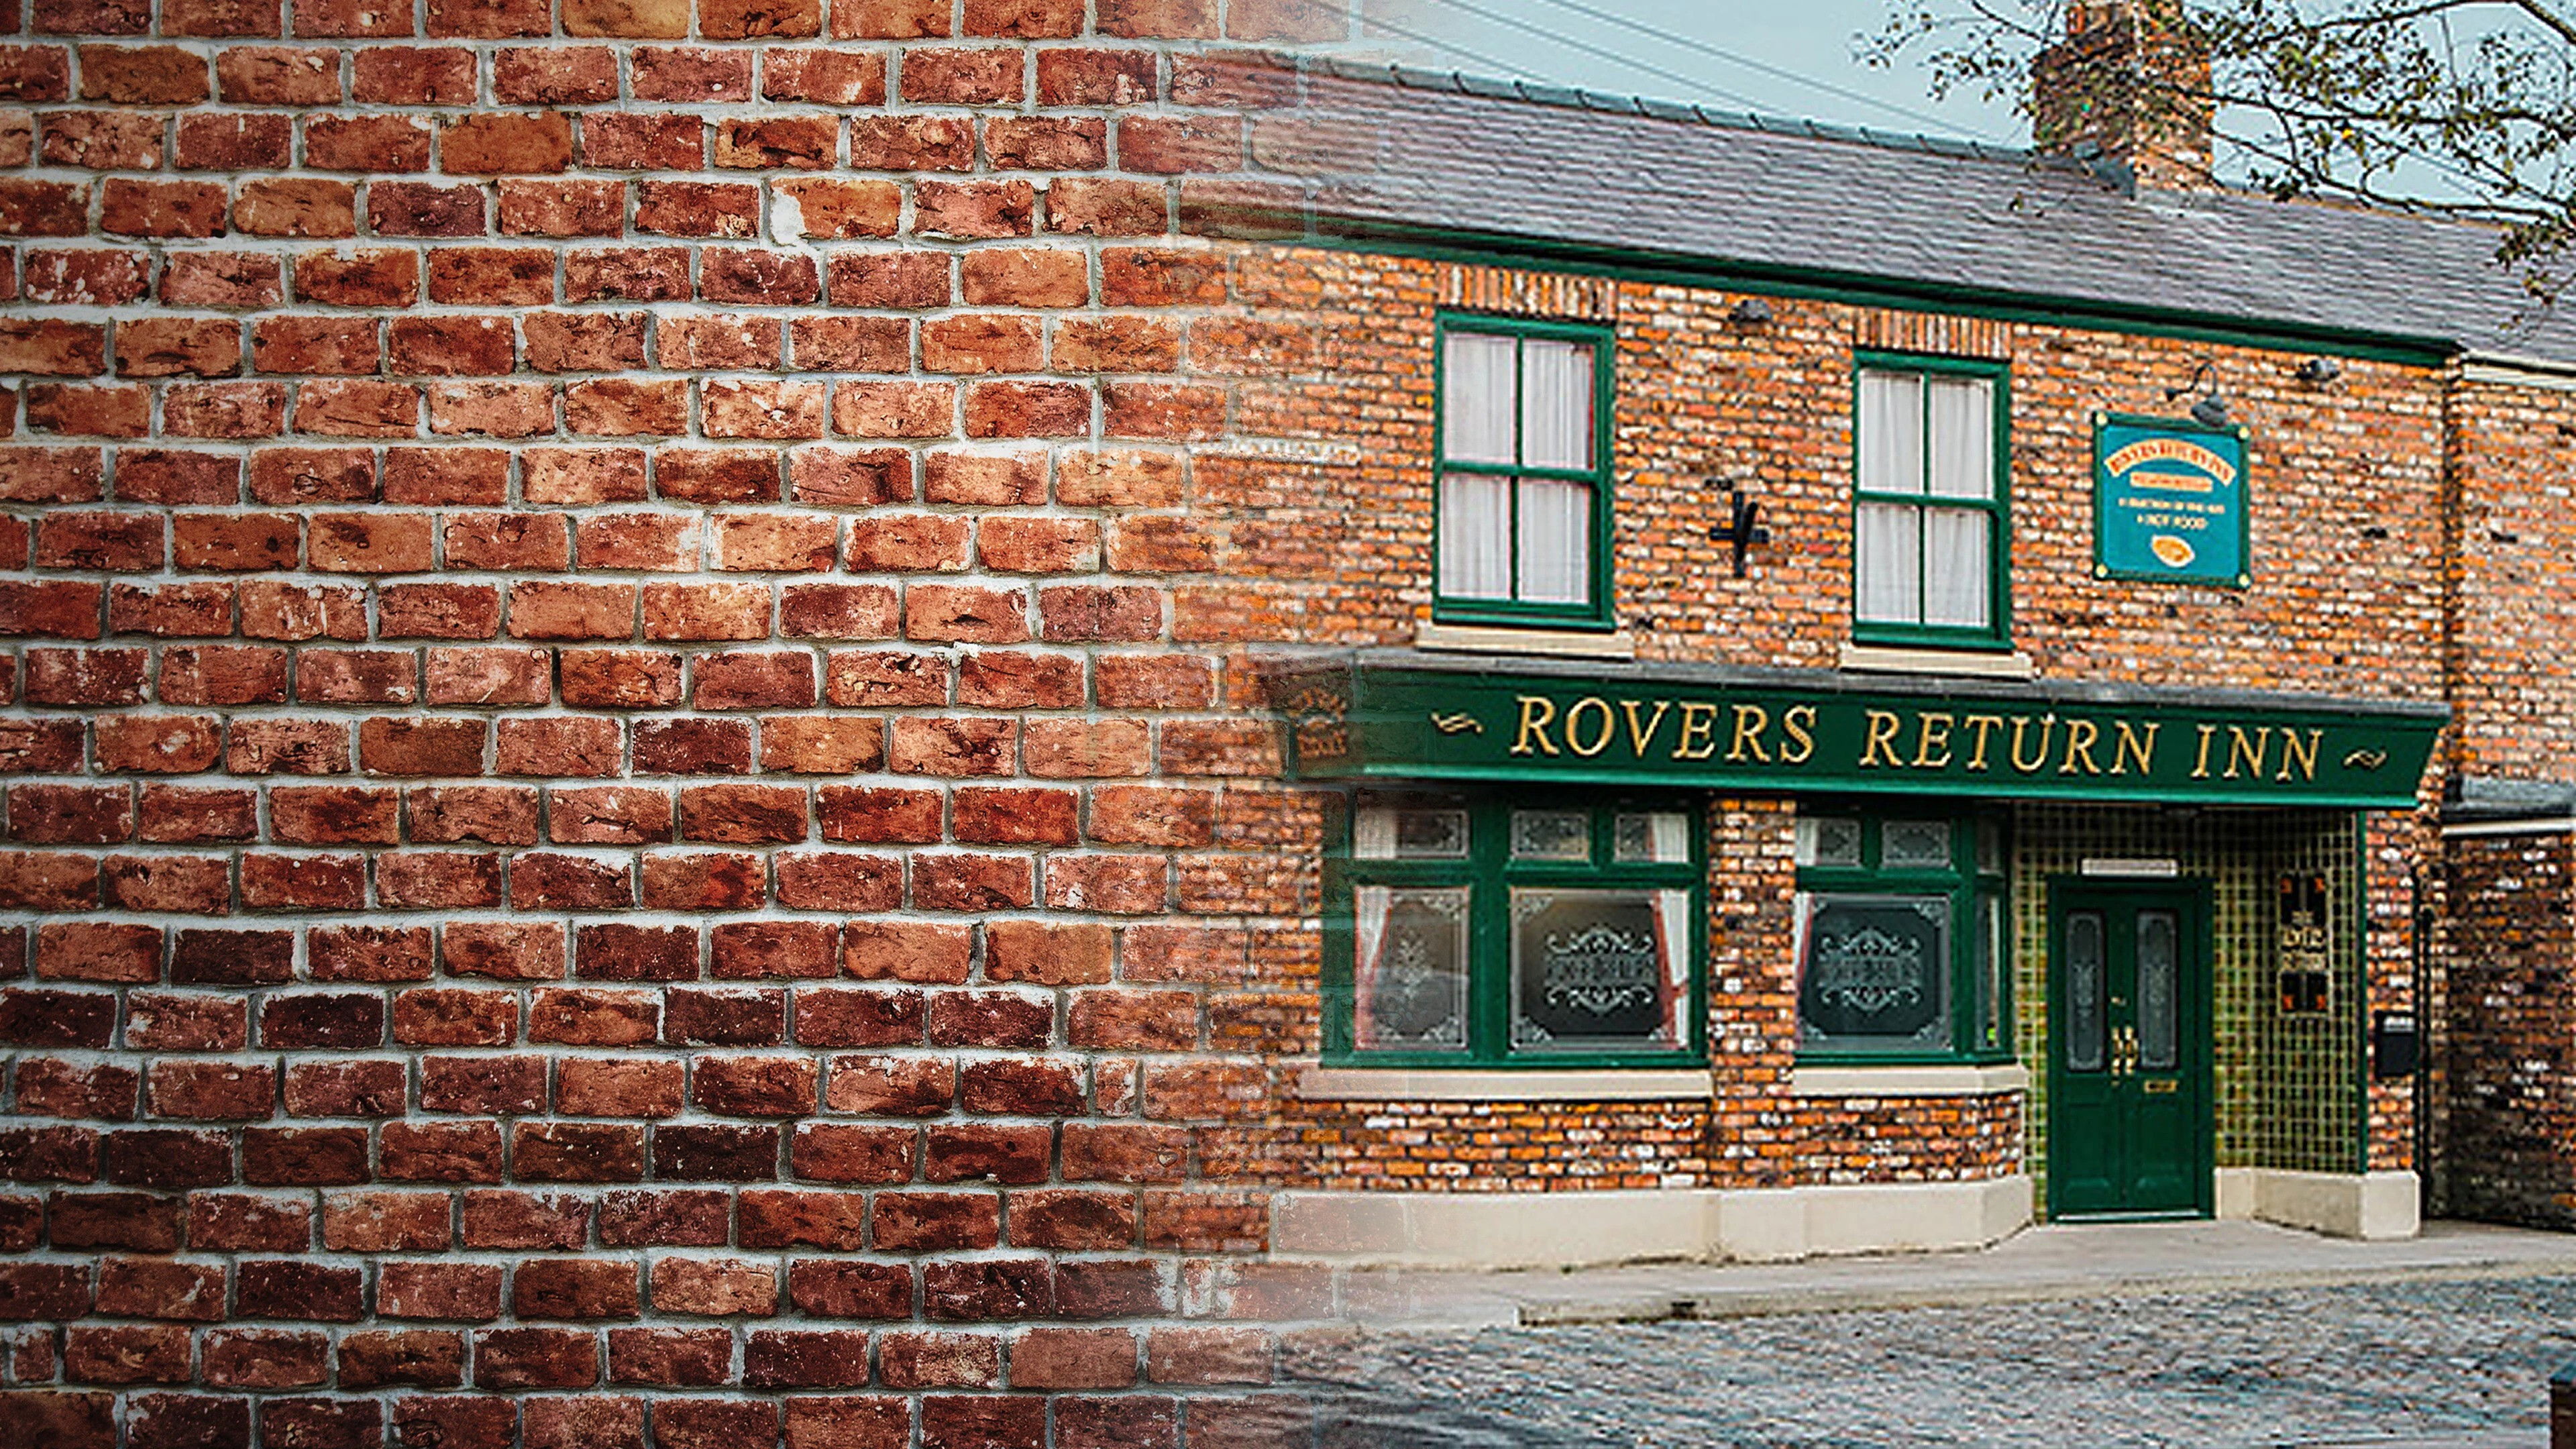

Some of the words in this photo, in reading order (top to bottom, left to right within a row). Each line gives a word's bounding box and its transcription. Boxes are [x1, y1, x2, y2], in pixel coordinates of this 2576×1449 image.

[1510, 695, 1816, 763] ROVERS
[1859, 708, 2161, 774] RETURN
[2190, 724, 2323, 781] INN
